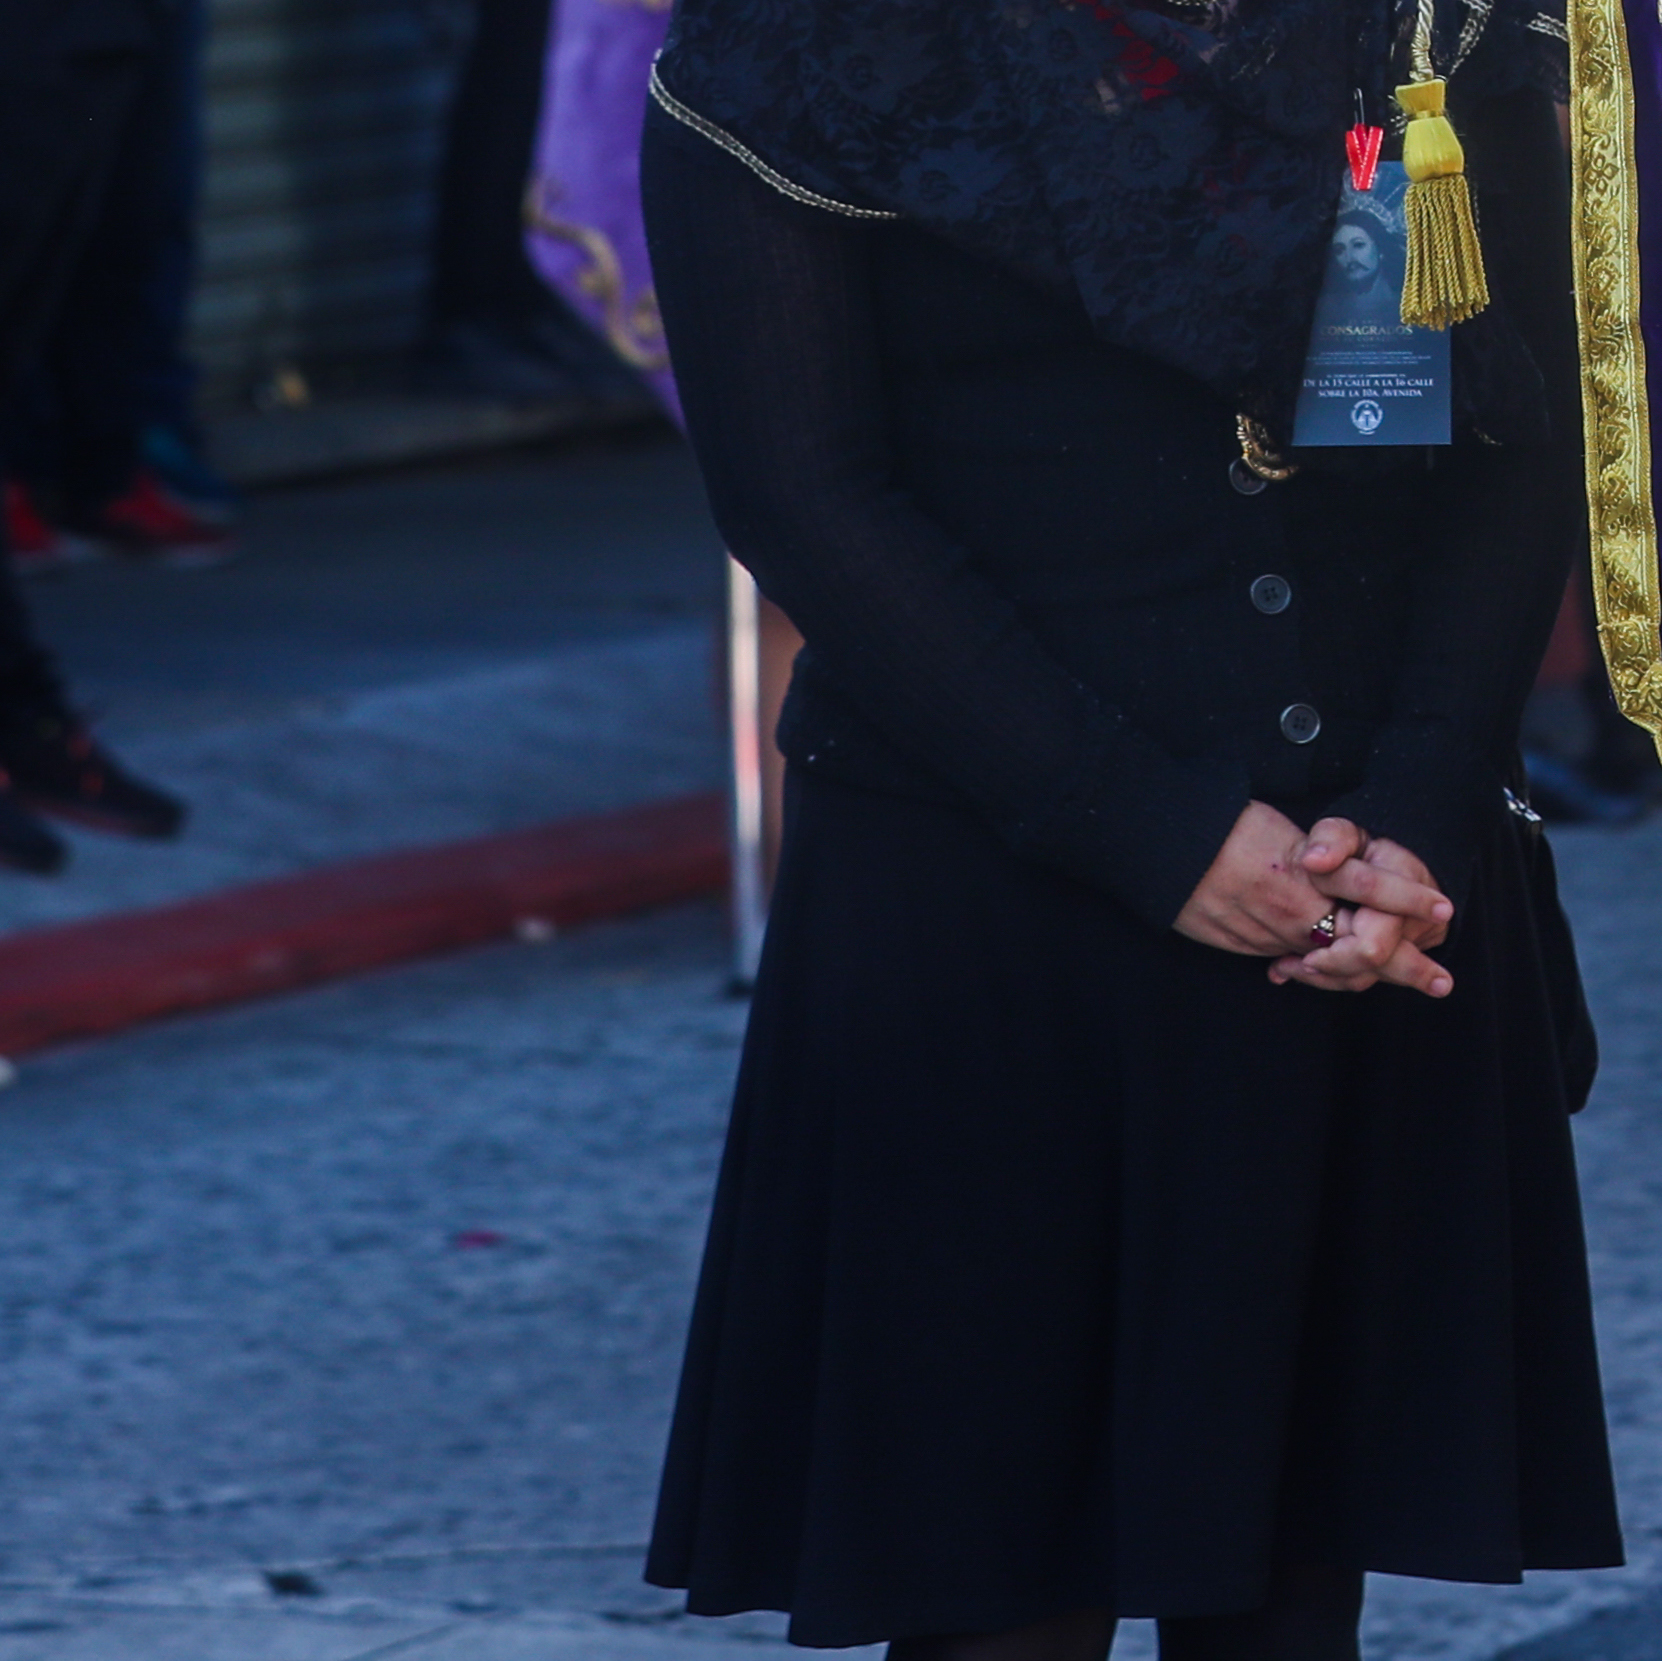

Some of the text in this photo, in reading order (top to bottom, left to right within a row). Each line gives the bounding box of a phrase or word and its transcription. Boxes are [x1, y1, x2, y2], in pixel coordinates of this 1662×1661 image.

[1344, 379, 1370, 387] CALLE
[1407, 378, 1433, 386] CALLE
[1382, 389, 1422, 397] AVENIDA
